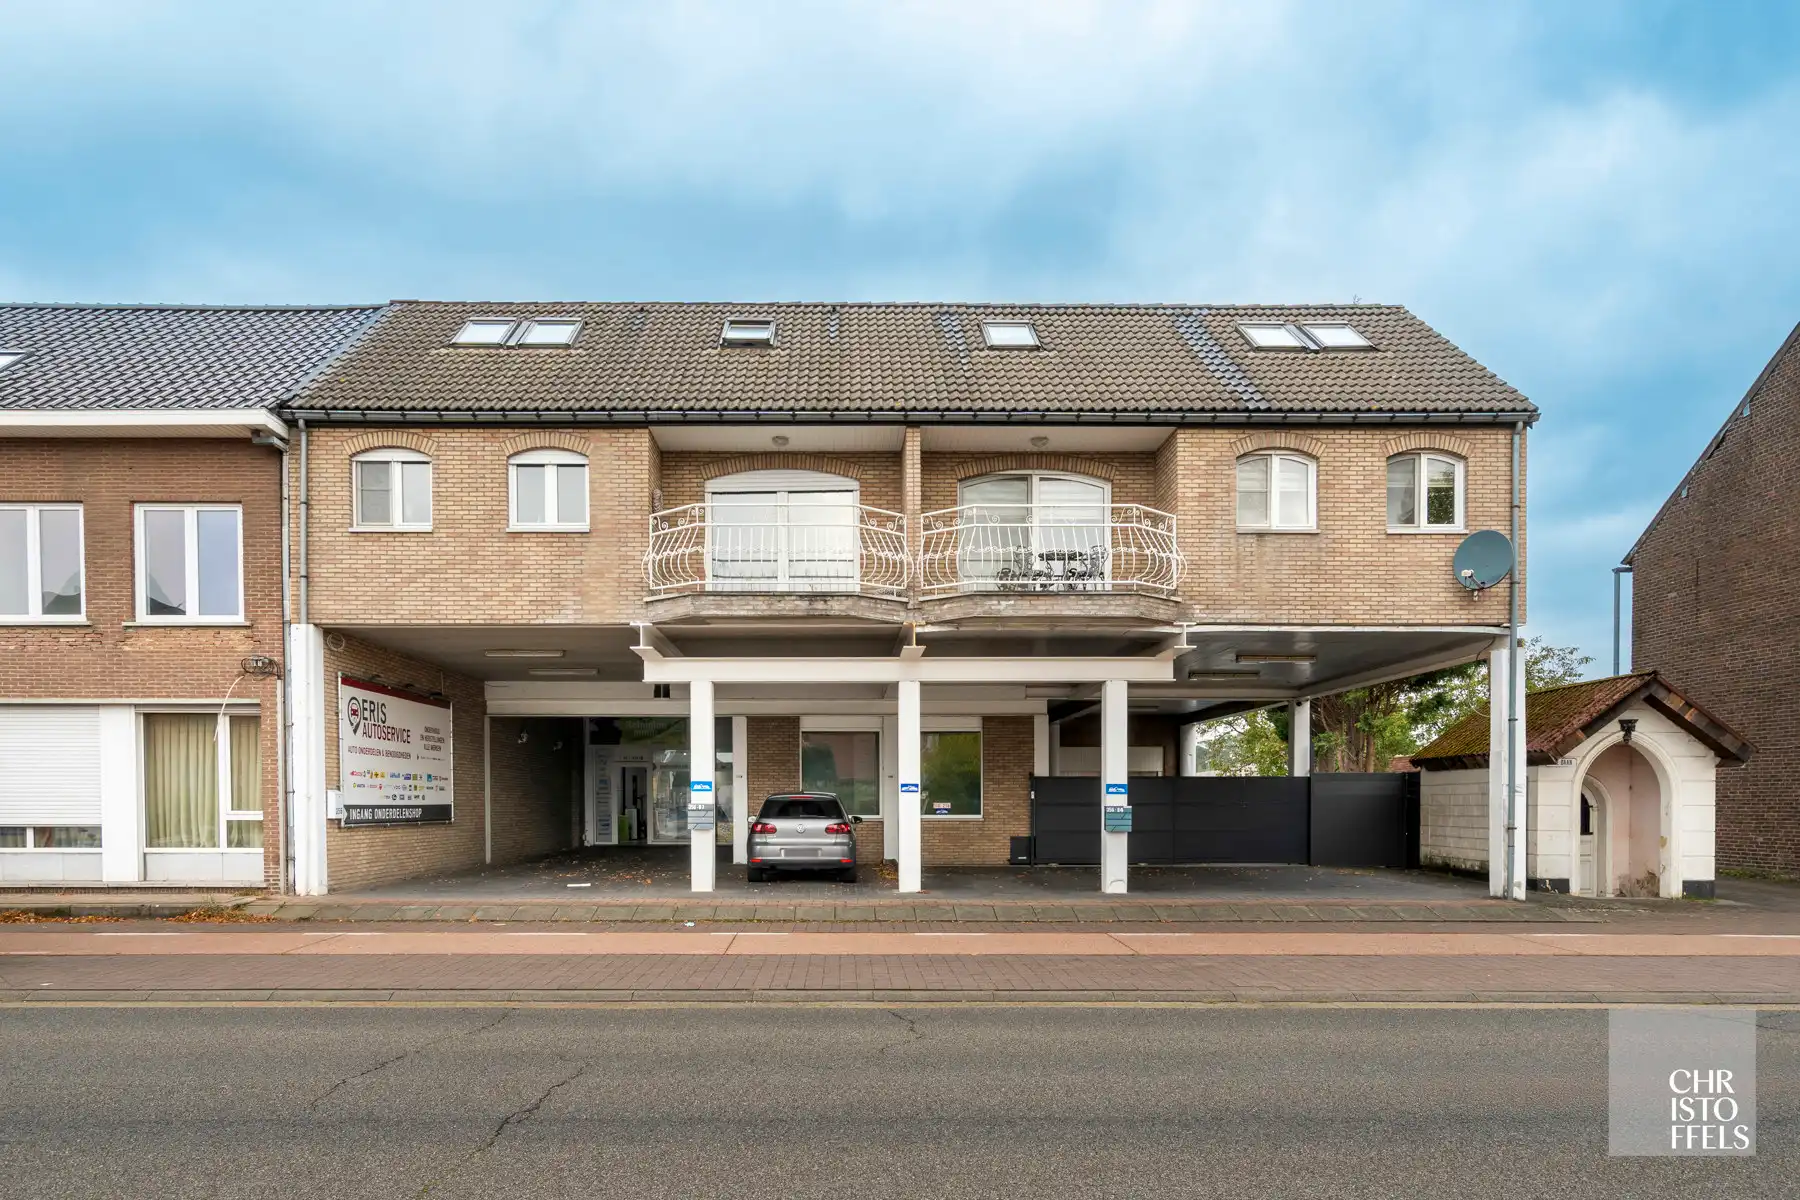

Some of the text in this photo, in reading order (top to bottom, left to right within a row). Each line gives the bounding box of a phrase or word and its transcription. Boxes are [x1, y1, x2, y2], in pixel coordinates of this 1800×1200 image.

[362, 699, 387, 724] ERIS
[362, 722, 411, 744] AUTOSERVICE
[349, 808, 373, 820] INGANG
[374, 808, 422, 820] ONDERDELENSHOP
